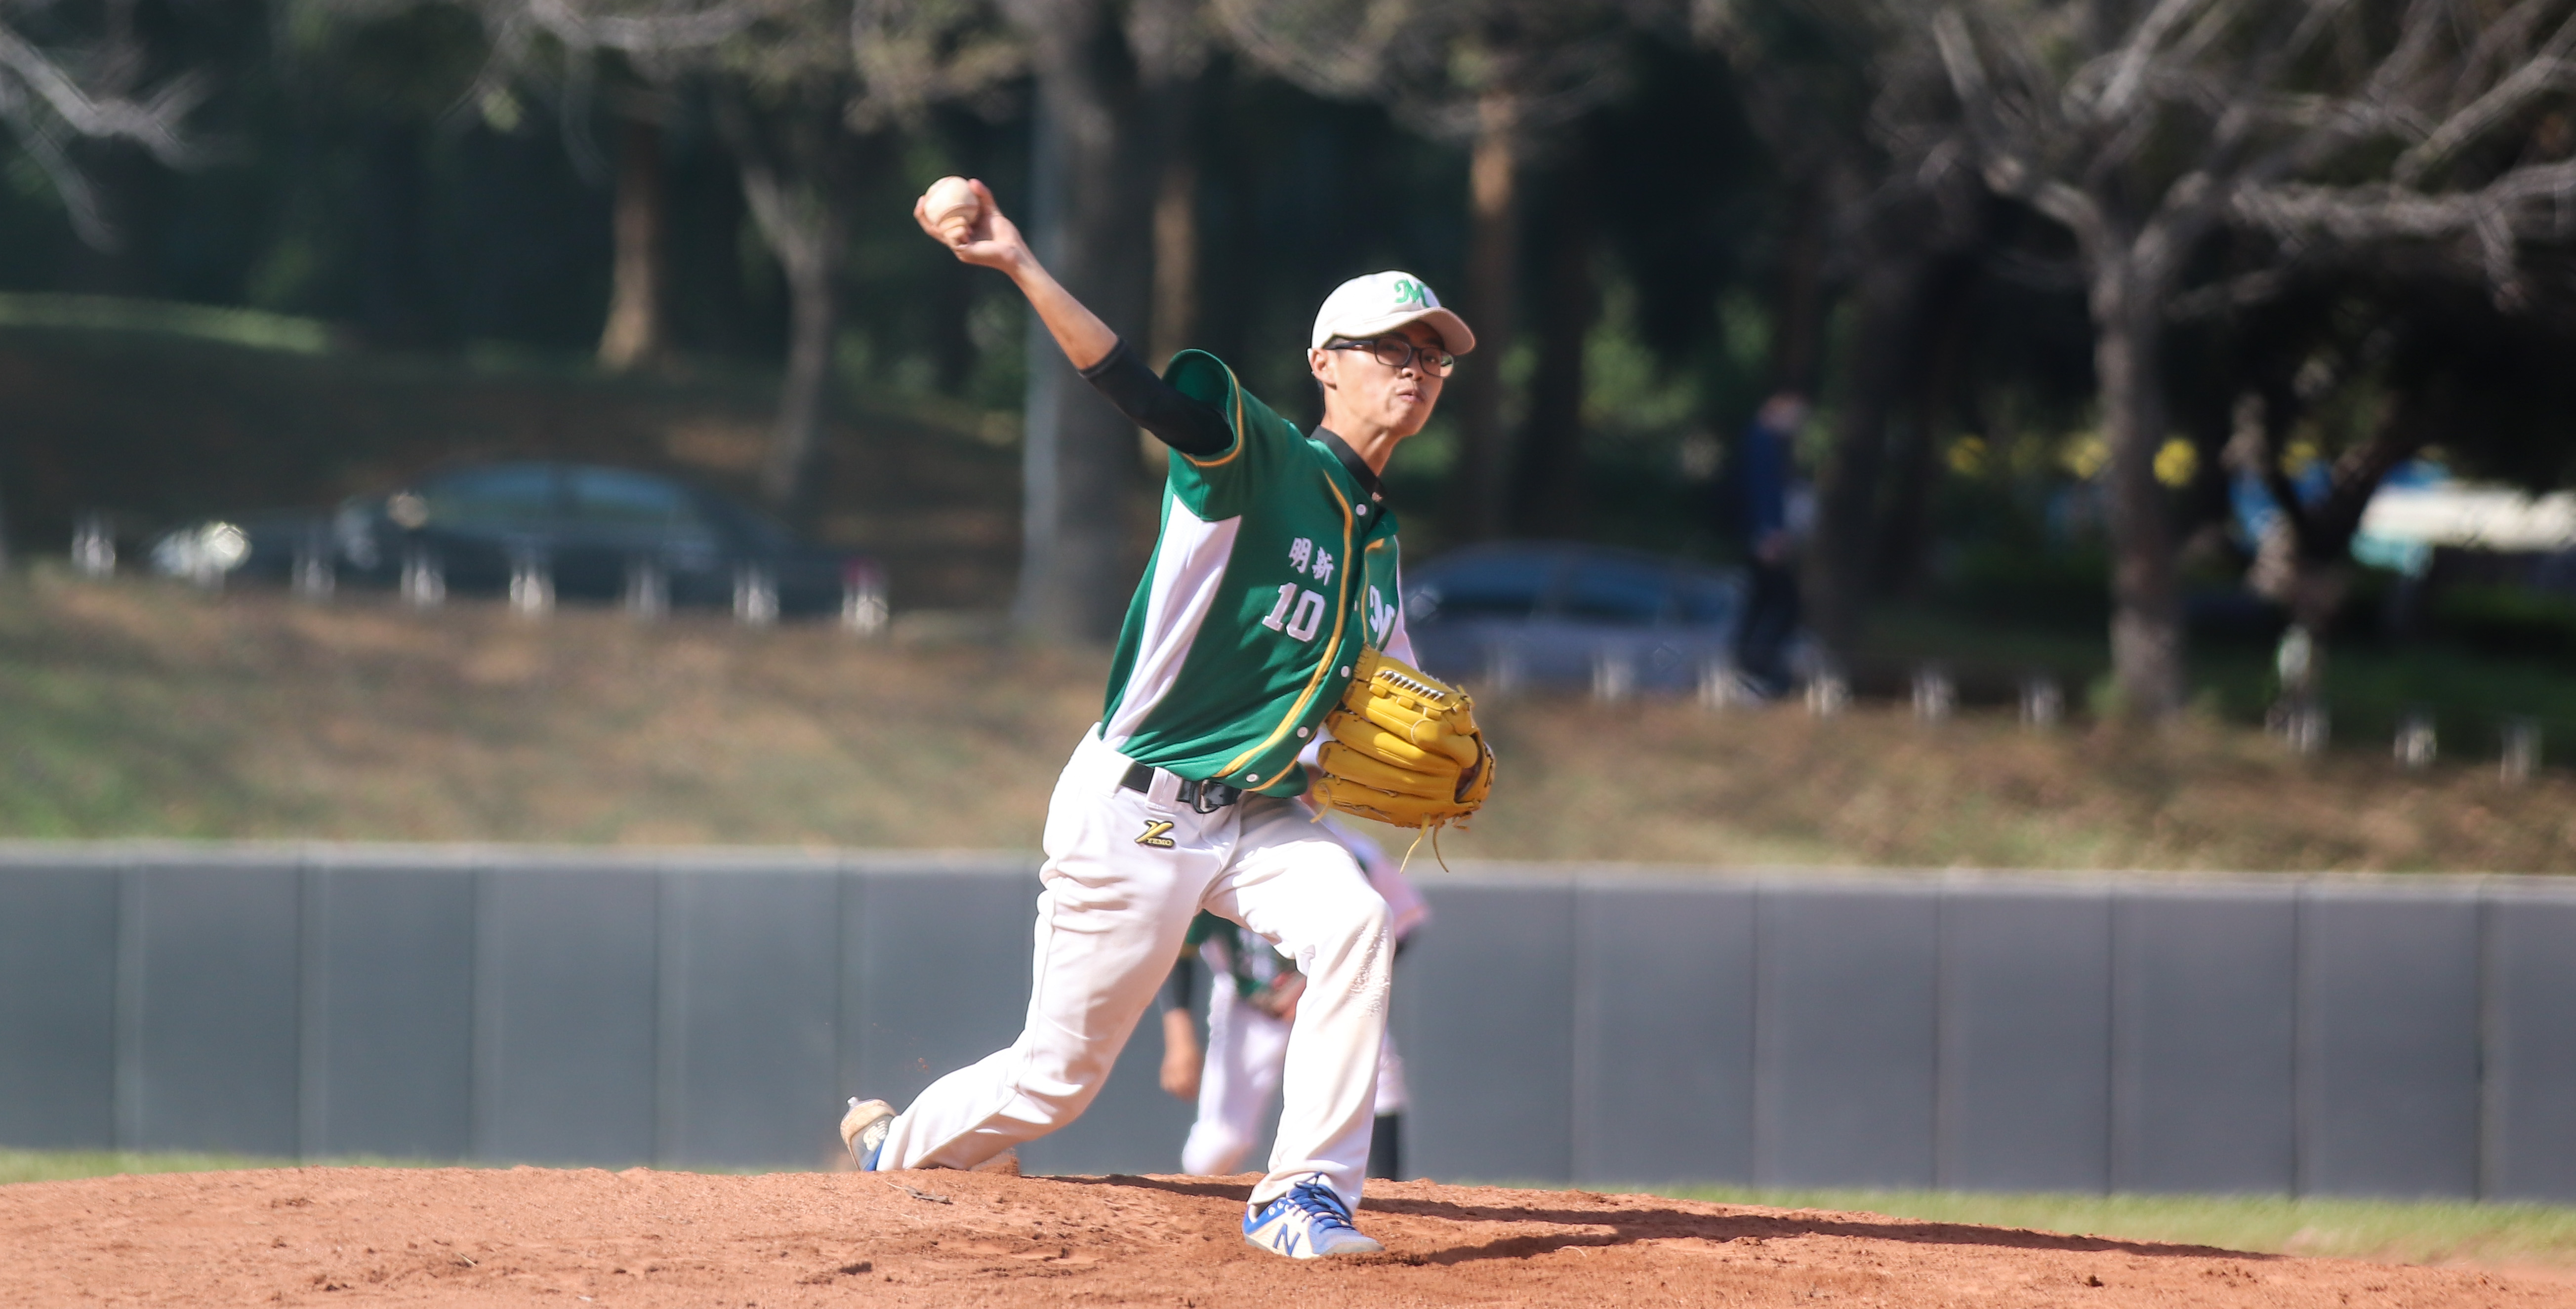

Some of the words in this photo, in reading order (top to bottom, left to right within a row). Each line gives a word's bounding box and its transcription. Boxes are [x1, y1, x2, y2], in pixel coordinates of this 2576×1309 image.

[1394, 279, 1431, 308] M
[1288, 537, 1334, 586] 明新
[1262, 582, 1325, 642] 10
[1272, 1223, 1301, 1256] N
